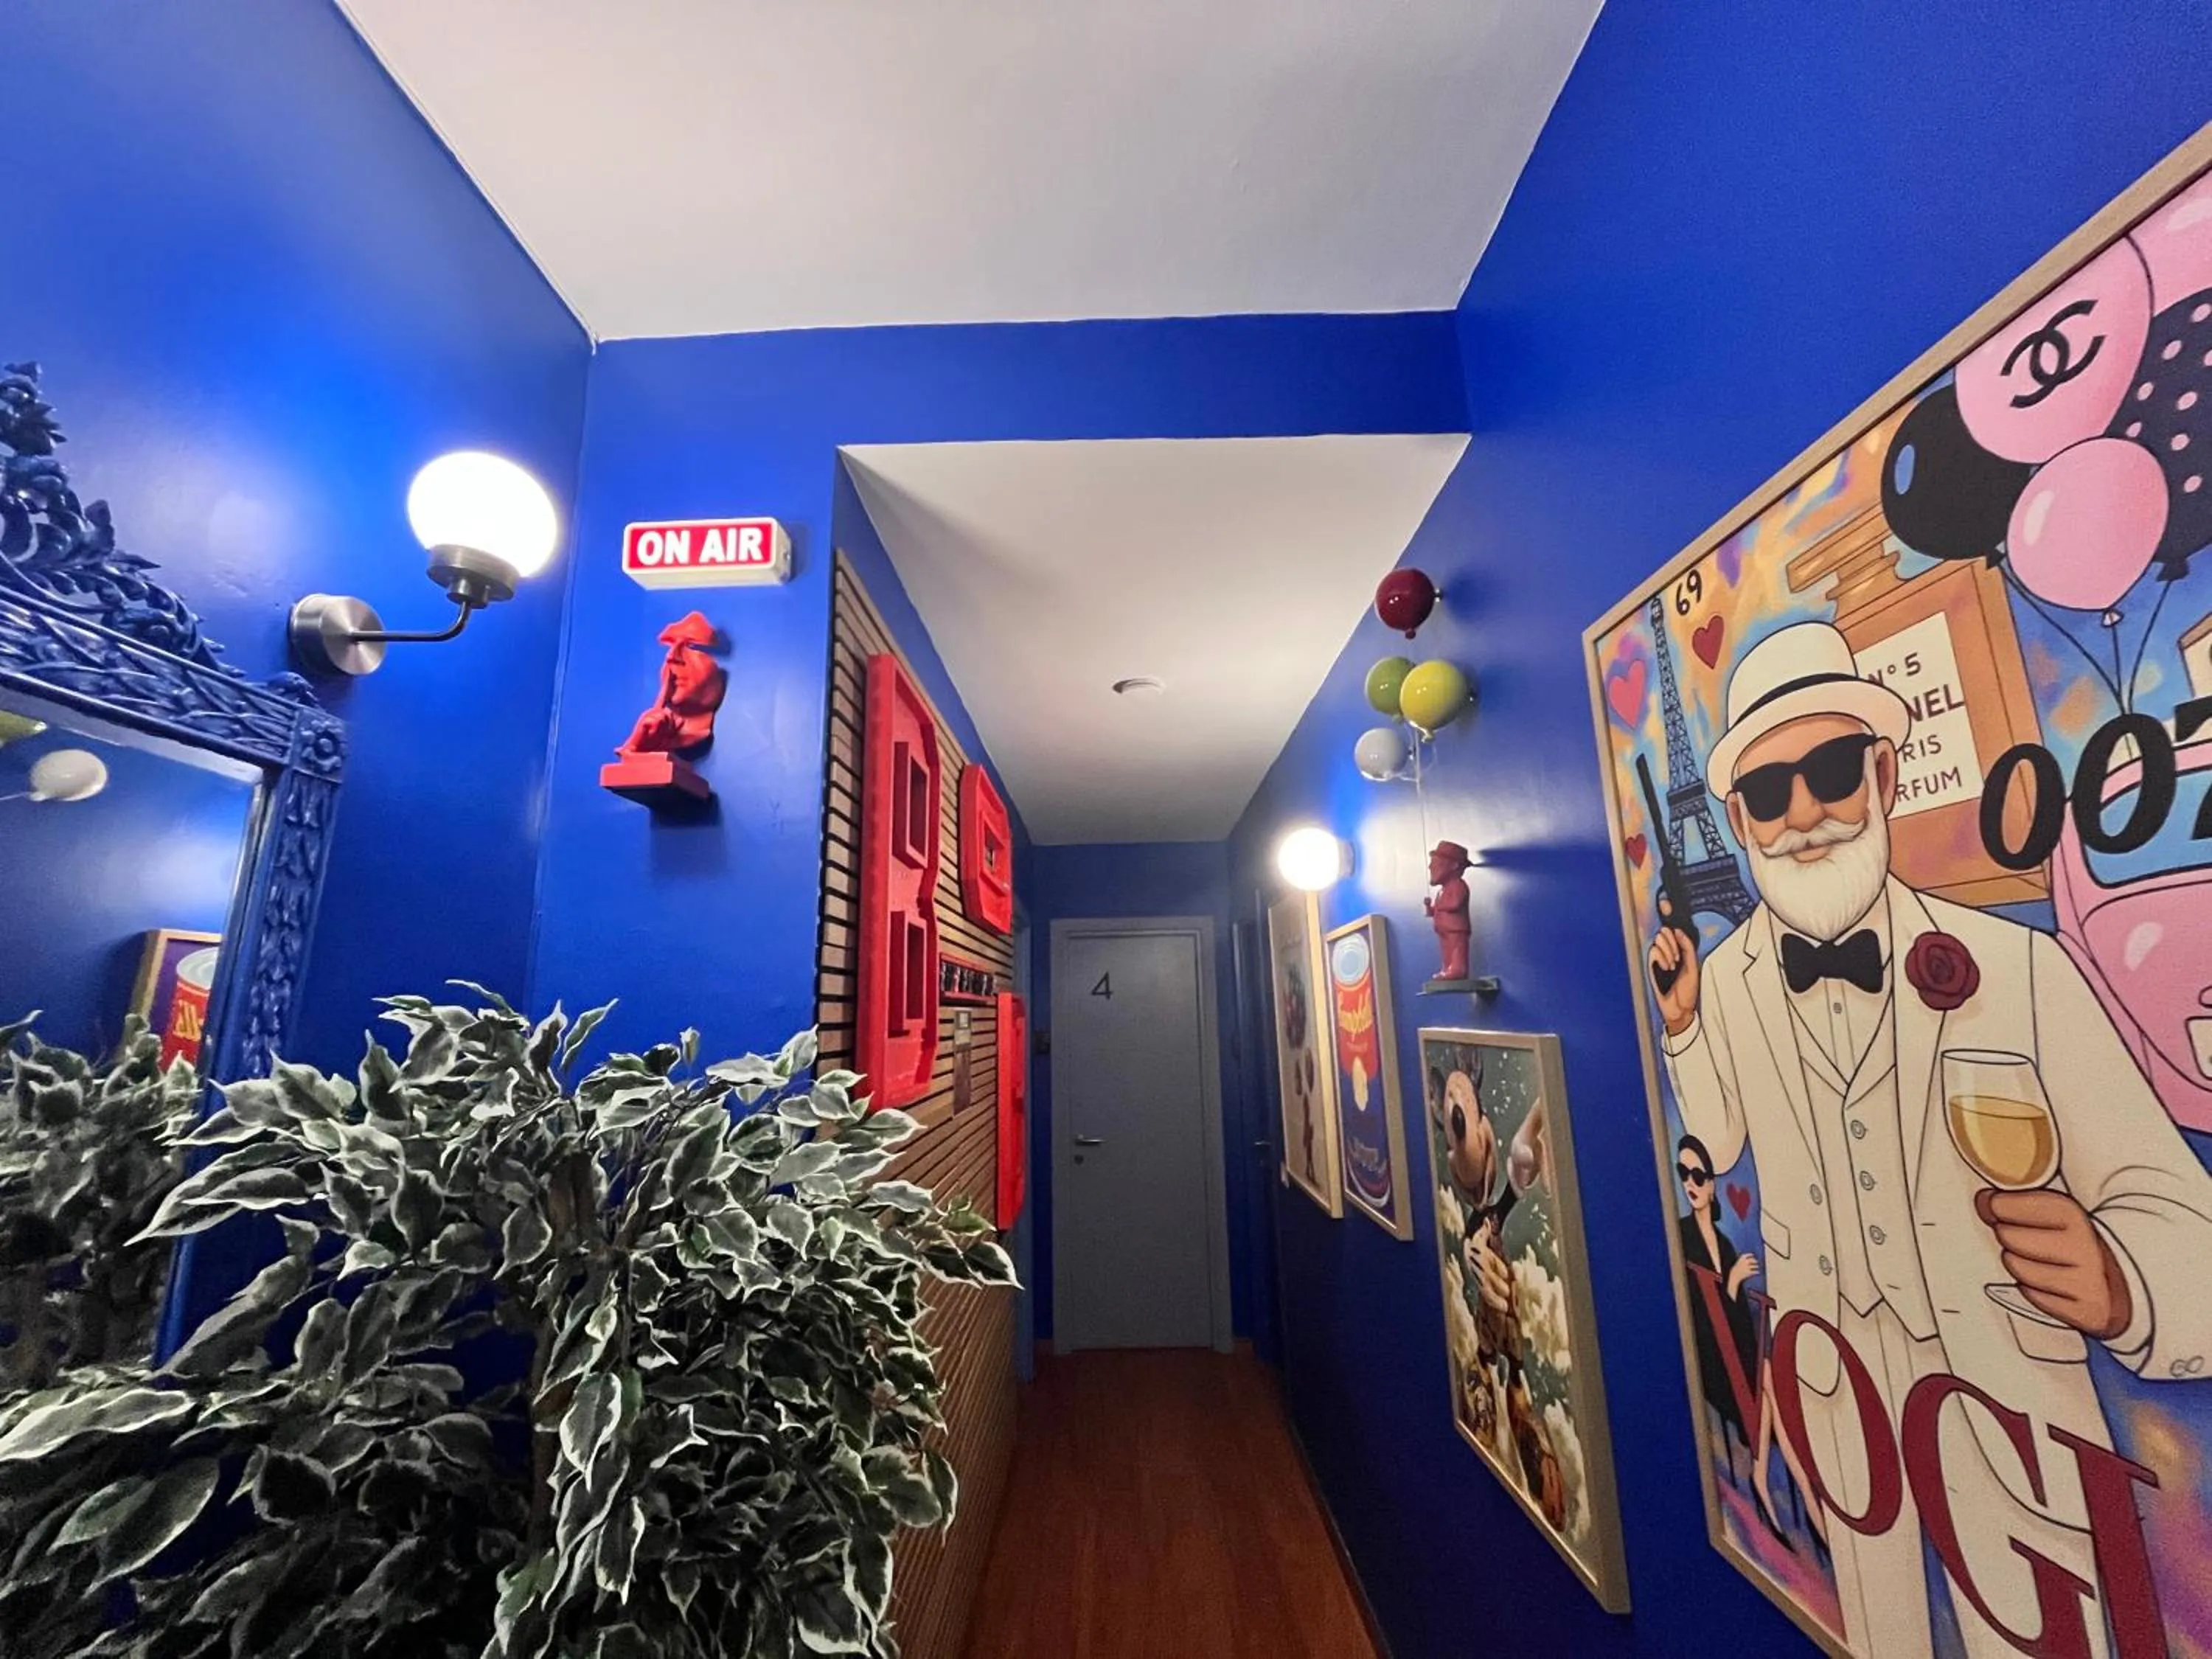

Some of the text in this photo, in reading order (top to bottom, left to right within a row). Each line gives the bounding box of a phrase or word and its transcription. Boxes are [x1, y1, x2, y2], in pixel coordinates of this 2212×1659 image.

[636, 527, 763, 566] ON AIR
[1676, 569, 1702, 616] 69
[1907, 684, 1965, 722] NEL
[1902, 734, 1941, 762] RIS
[1897, 767, 1962, 802] RFUM
[1091, 971, 1113, 1000] 4
